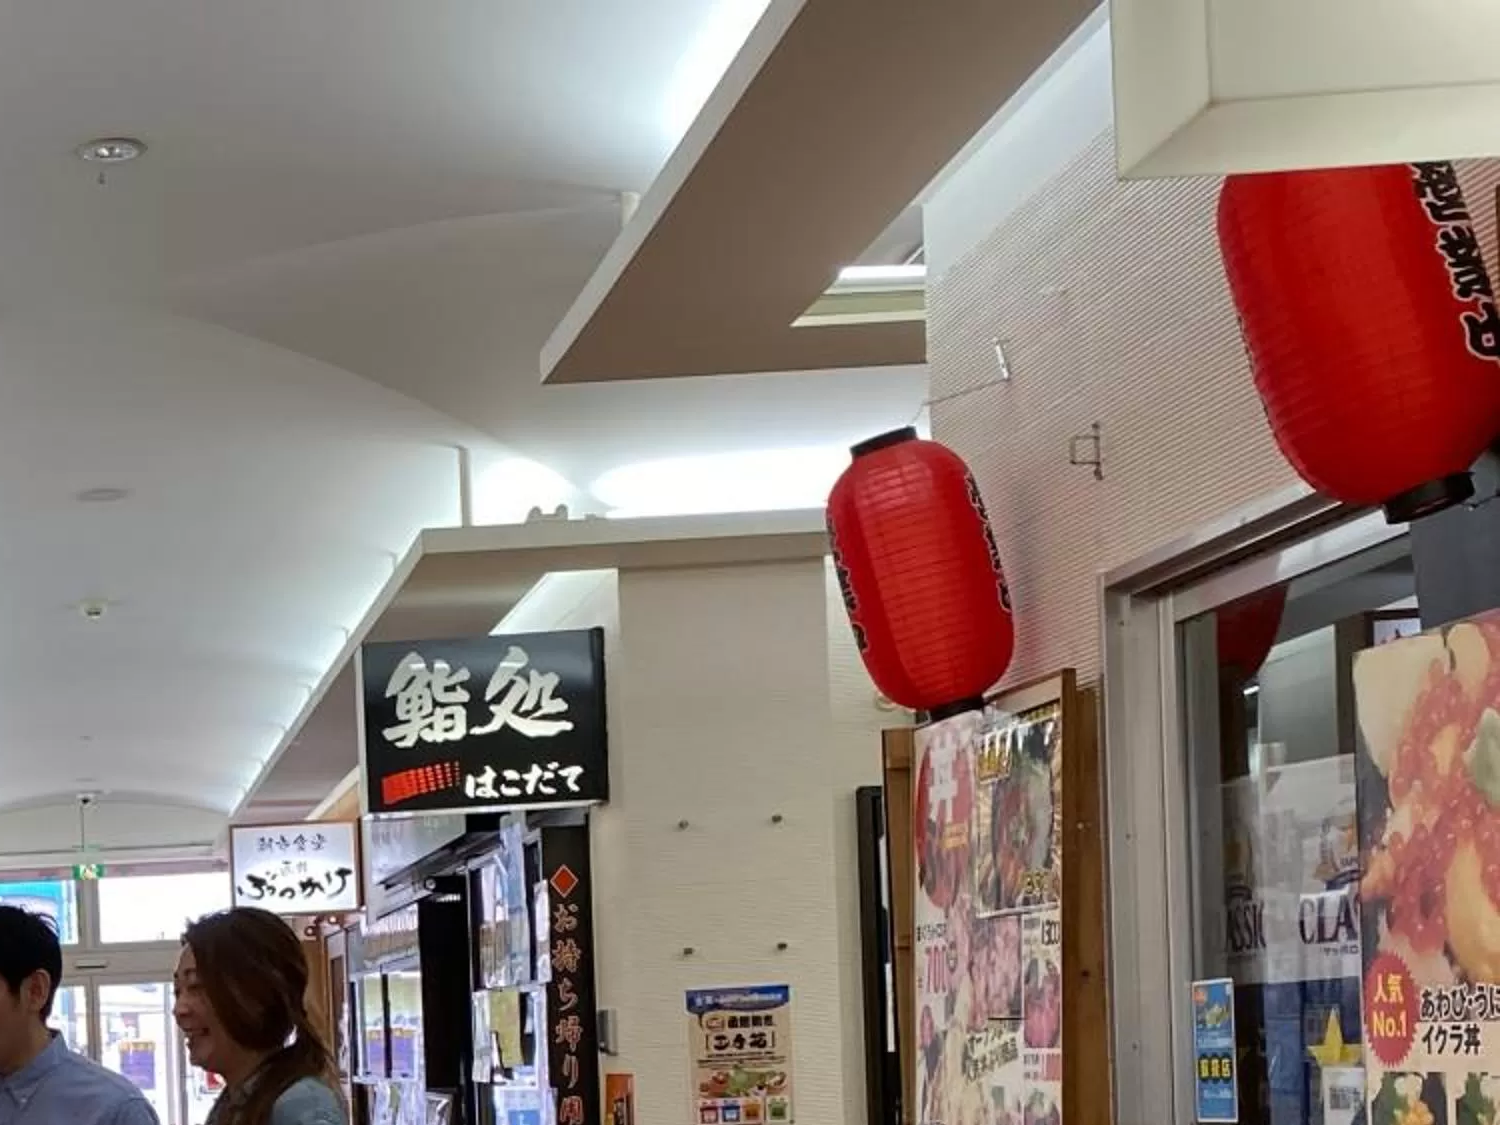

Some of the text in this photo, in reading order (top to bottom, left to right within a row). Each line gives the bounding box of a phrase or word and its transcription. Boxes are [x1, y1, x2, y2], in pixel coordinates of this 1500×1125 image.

[382, 645, 575, 749] 鮨処
[465, 762, 585, 800] はこだて
[1375, 973, 1404, 1004] 人気
[1373, 1012, 1407, 1038] No.1
[1421, 1025, 1481, 1055] イクラ丼
